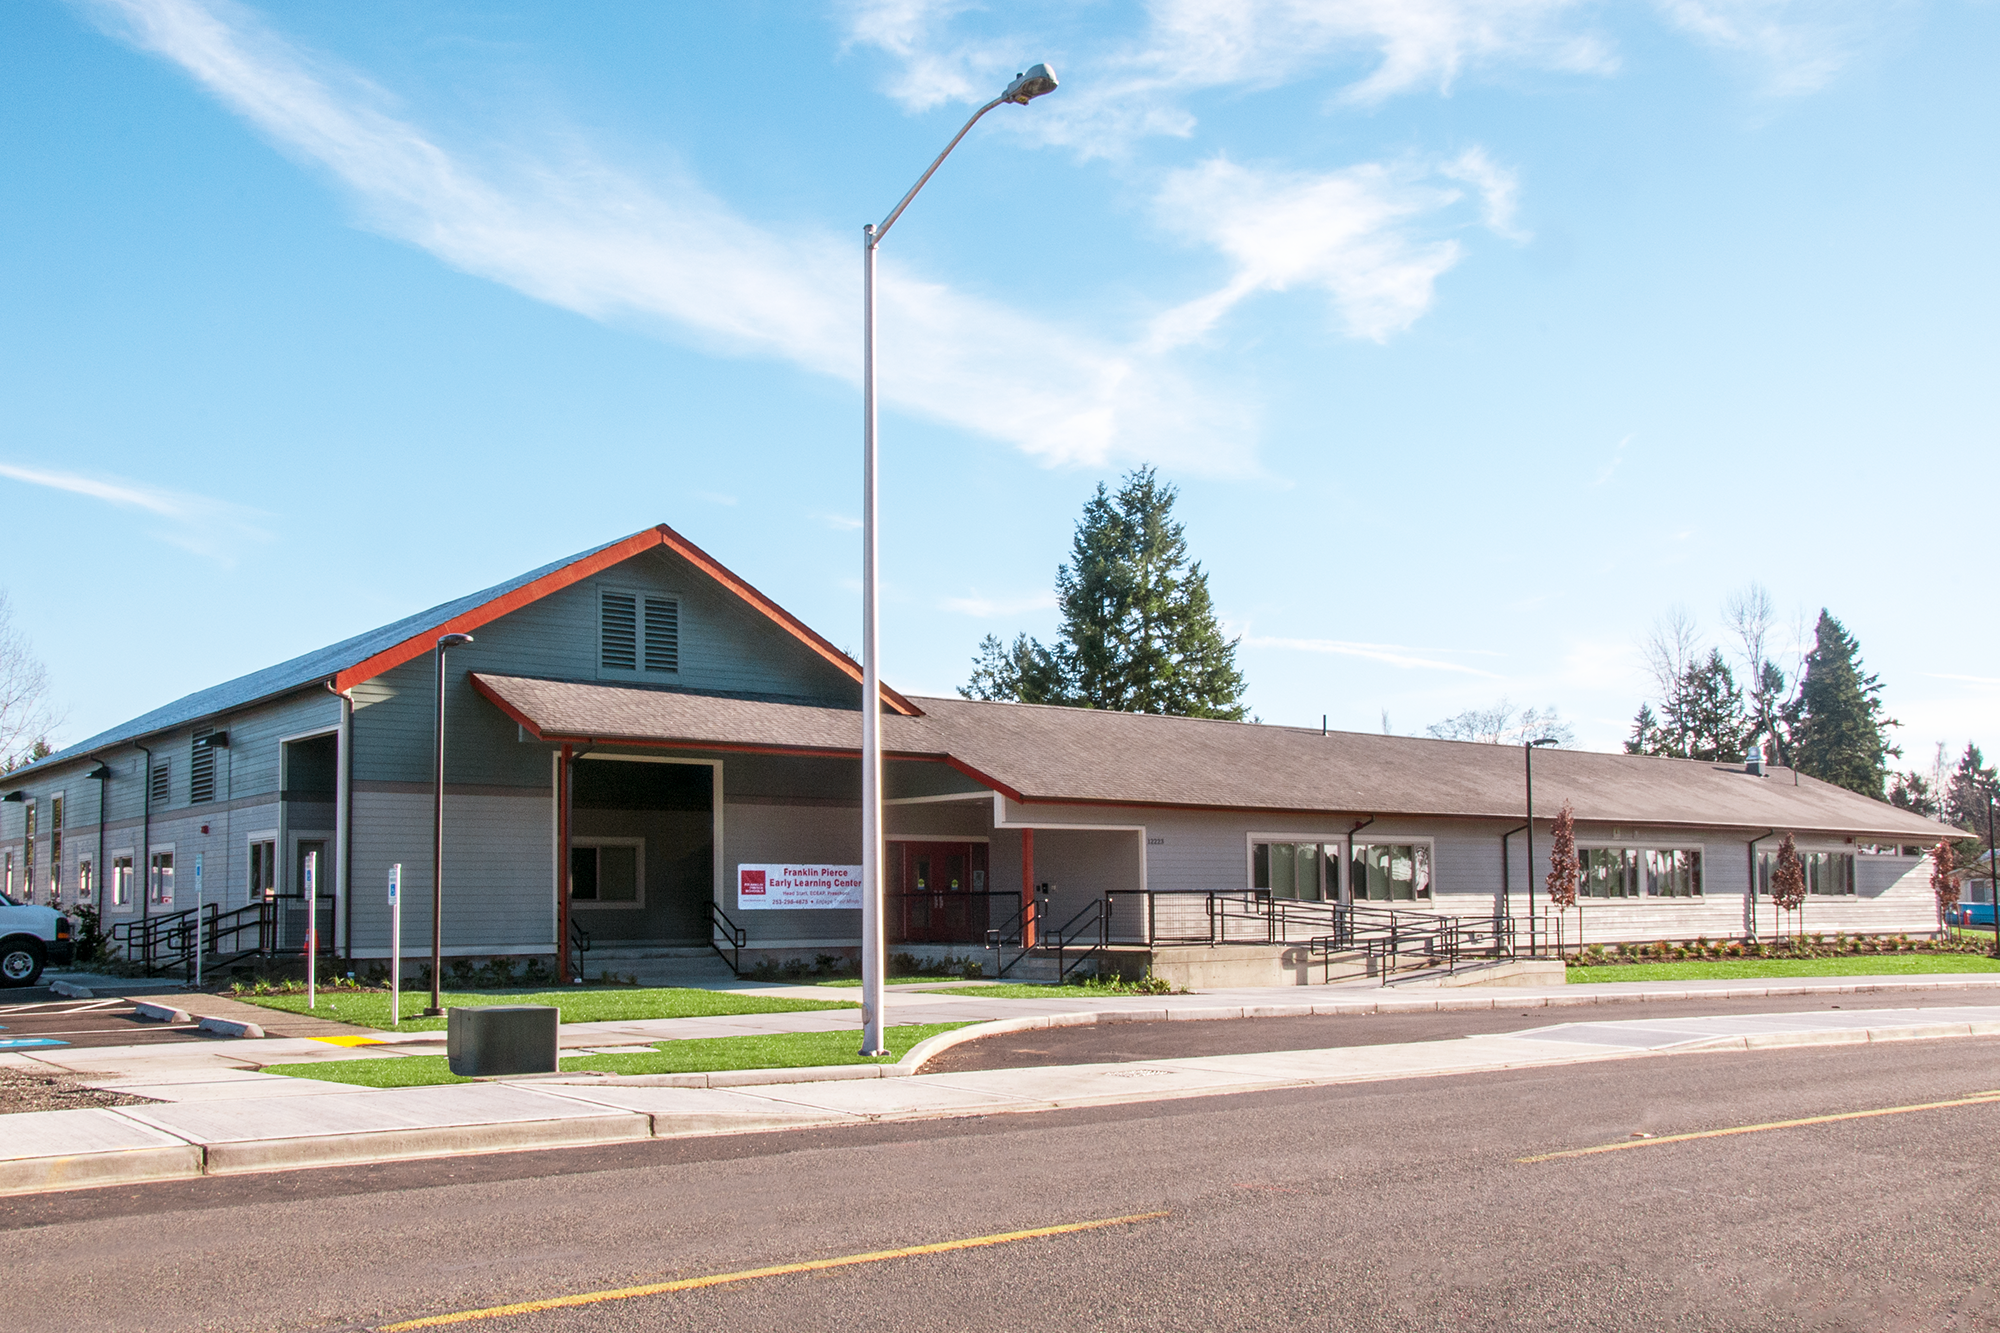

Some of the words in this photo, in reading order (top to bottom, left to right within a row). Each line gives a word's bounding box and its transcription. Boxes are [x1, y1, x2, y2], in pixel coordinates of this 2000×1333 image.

[783, 868, 819, 877] Franklin
[821, 868, 848, 877] Pierce
[769, 878, 792, 889] Early
[794, 878, 832, 889] Learning
[834, 878, 862, 887] Center
